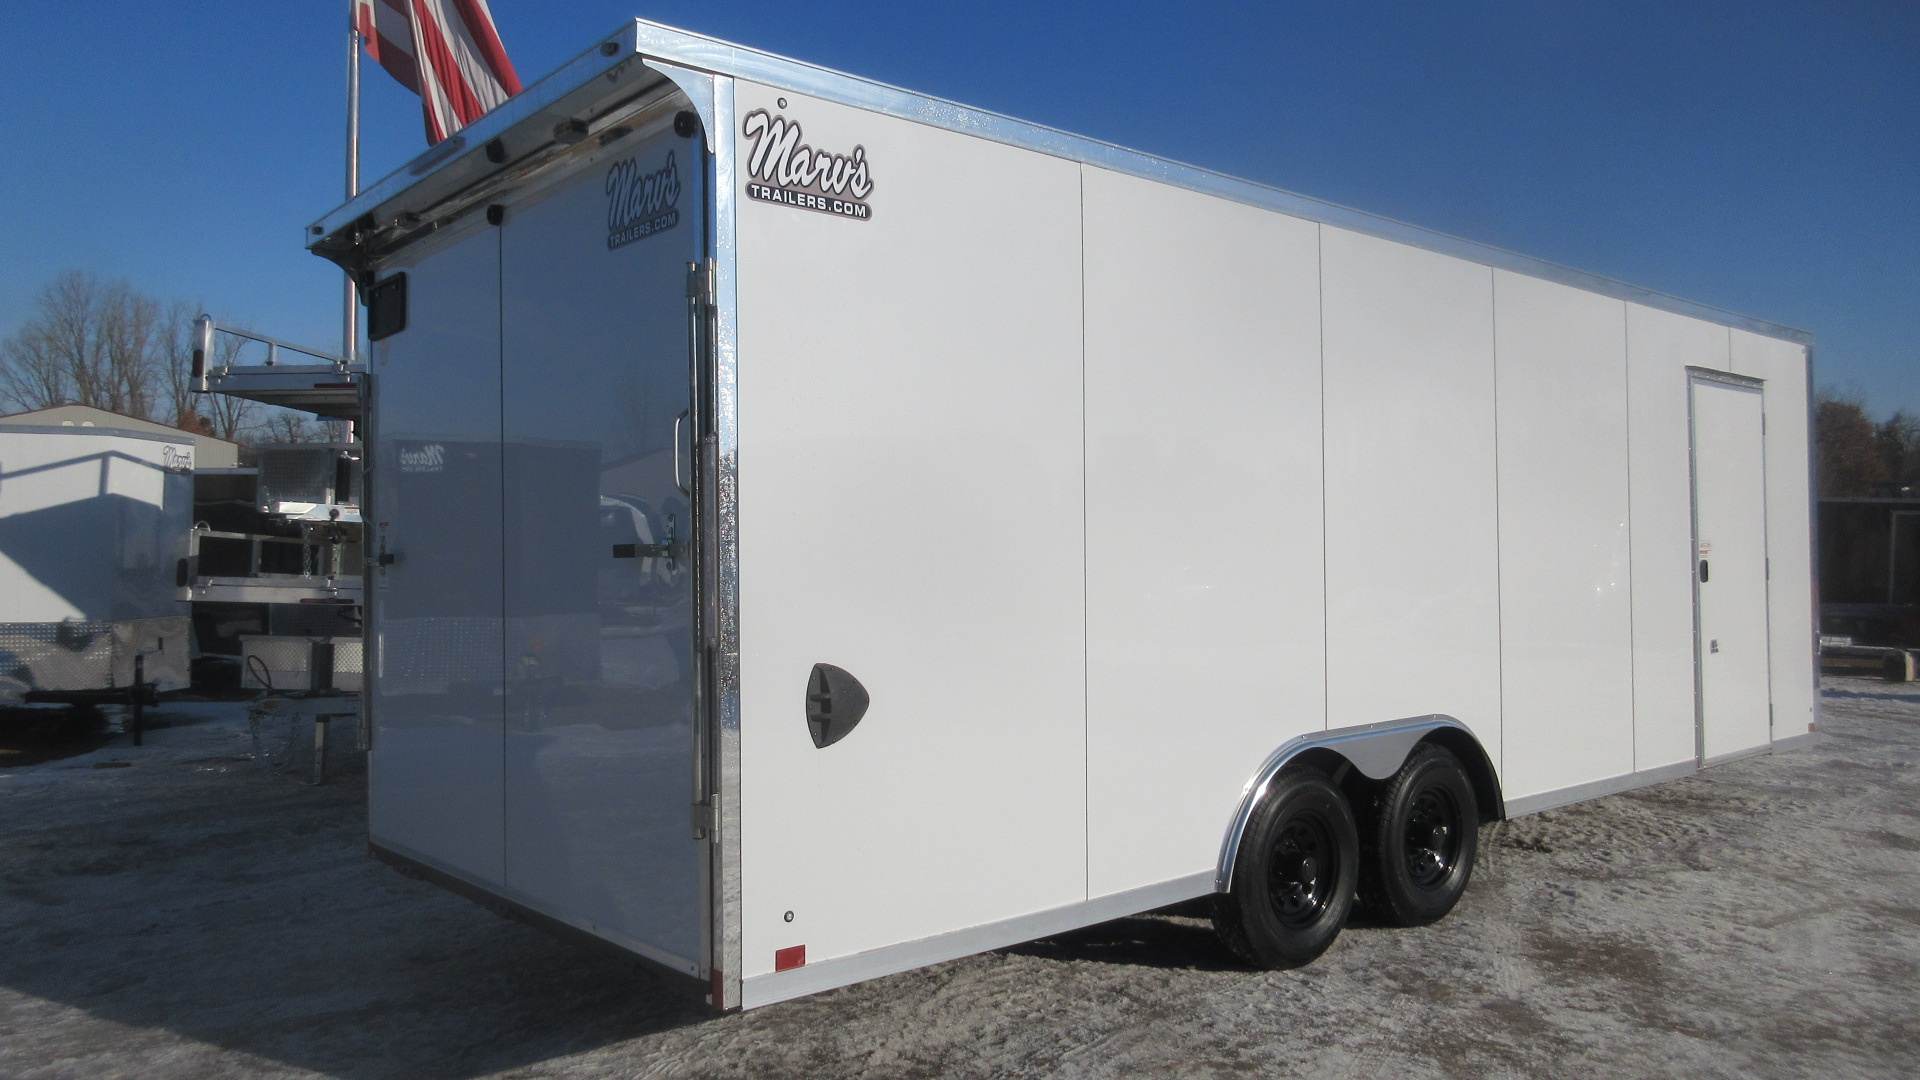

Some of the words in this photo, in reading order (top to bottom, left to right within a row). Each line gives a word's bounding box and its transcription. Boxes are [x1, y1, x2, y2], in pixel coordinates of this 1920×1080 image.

[745, 110, 873, 199] Marv's
[607, 150, 680, 230] Marv's
[751, 184, 866, 217] TRAILERS.COM
[610, 212, 676, 248] TRAILERS.COM
